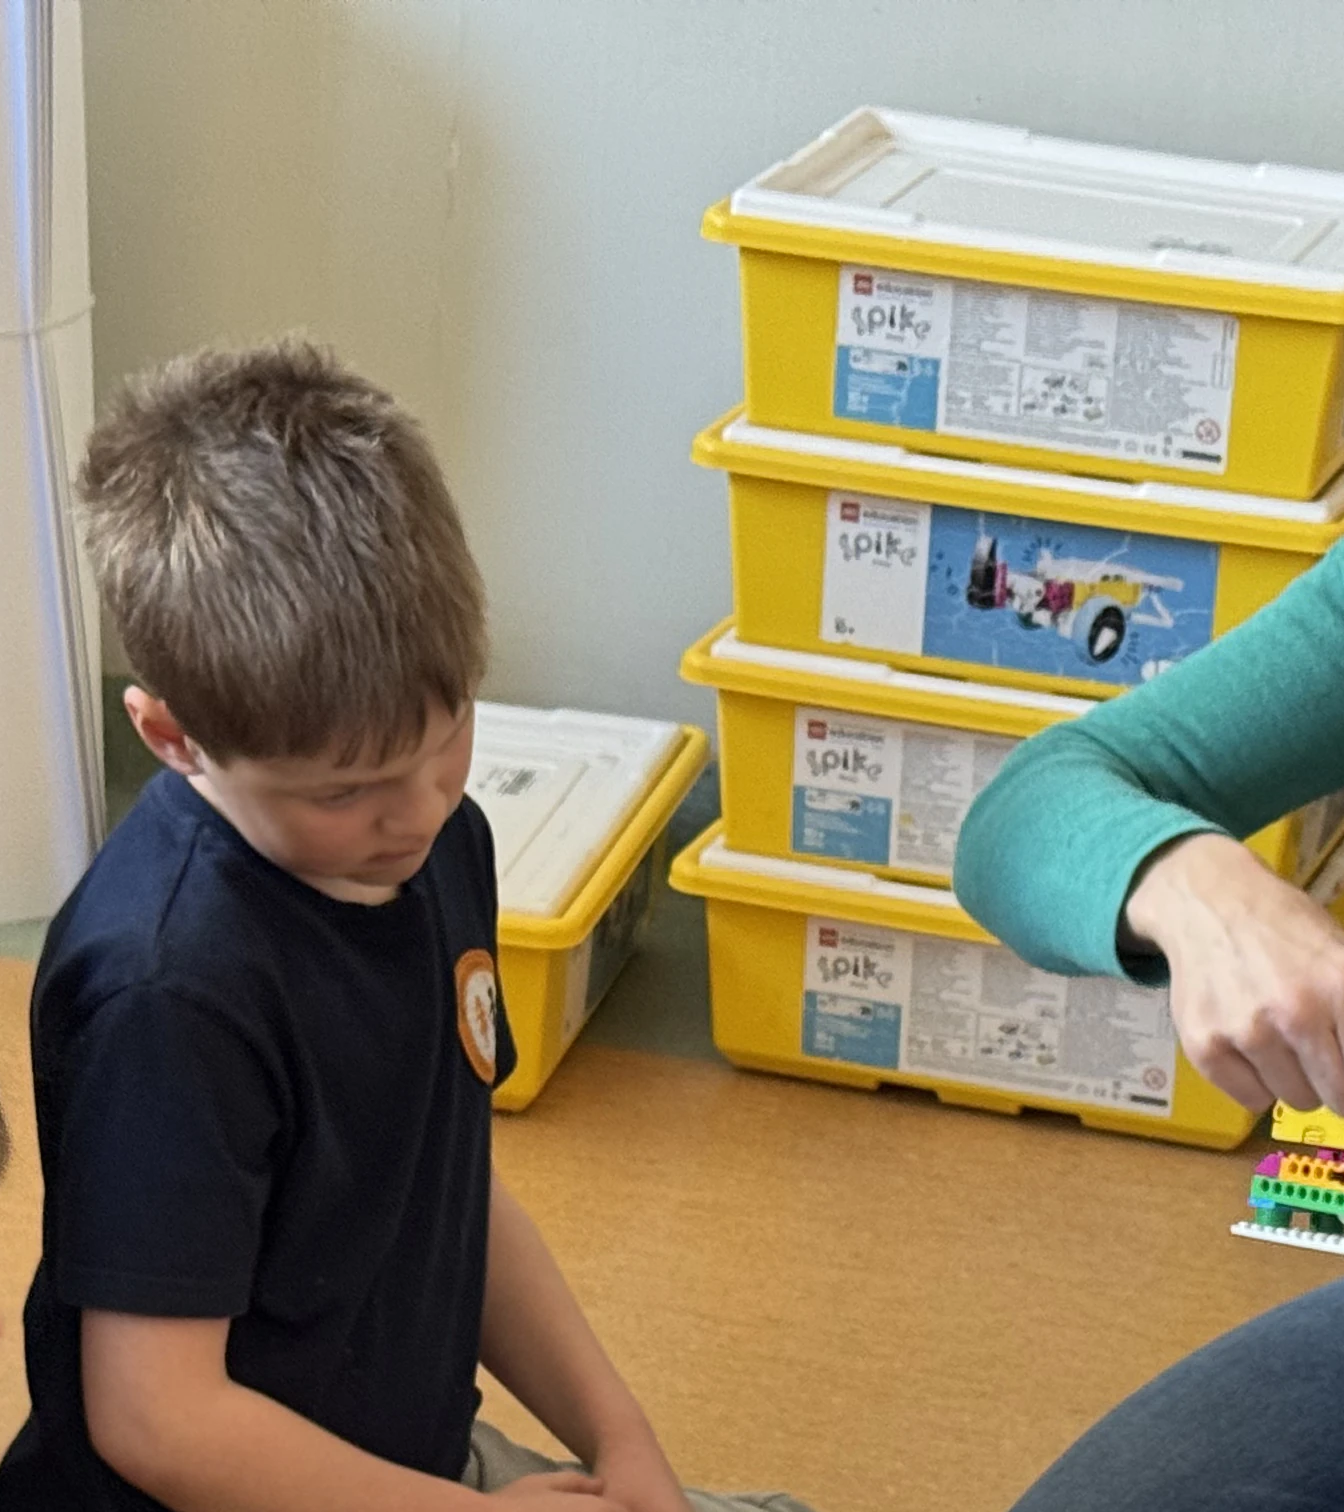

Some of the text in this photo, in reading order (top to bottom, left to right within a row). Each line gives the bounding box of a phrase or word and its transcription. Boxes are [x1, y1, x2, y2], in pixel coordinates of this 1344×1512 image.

[851, 304, 932, 342] spike
[838, 531, 918, 568] spike
[806, 747, 884, 782] spike
[817, 955, 894, 989] spike
